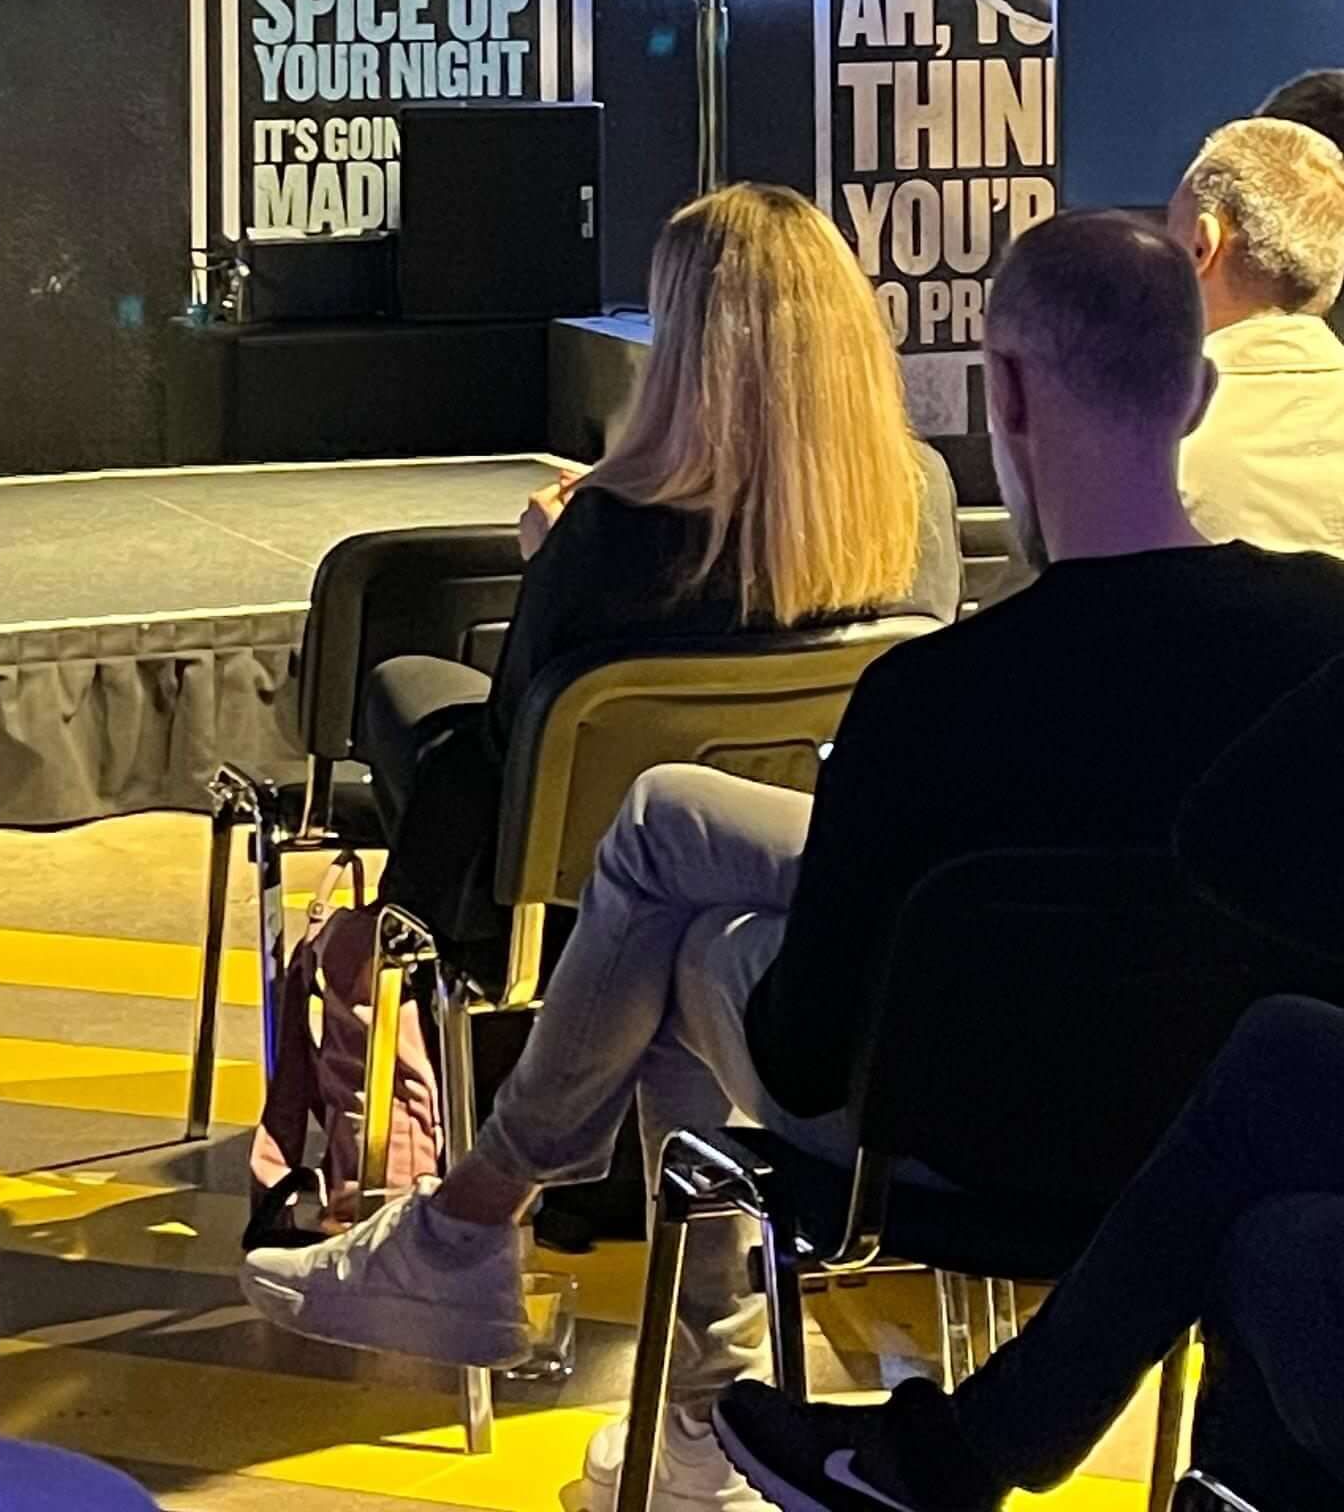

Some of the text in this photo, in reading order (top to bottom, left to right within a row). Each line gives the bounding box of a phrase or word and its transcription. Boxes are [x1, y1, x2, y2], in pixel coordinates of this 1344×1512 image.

[253, 40, 531, 102] YOUR NIGHT
[253, 117, 401, 163] IT'S GOIN
[837, 57, 1056, 172] THIN
[841, 176, 1056, 277] YOU'R
